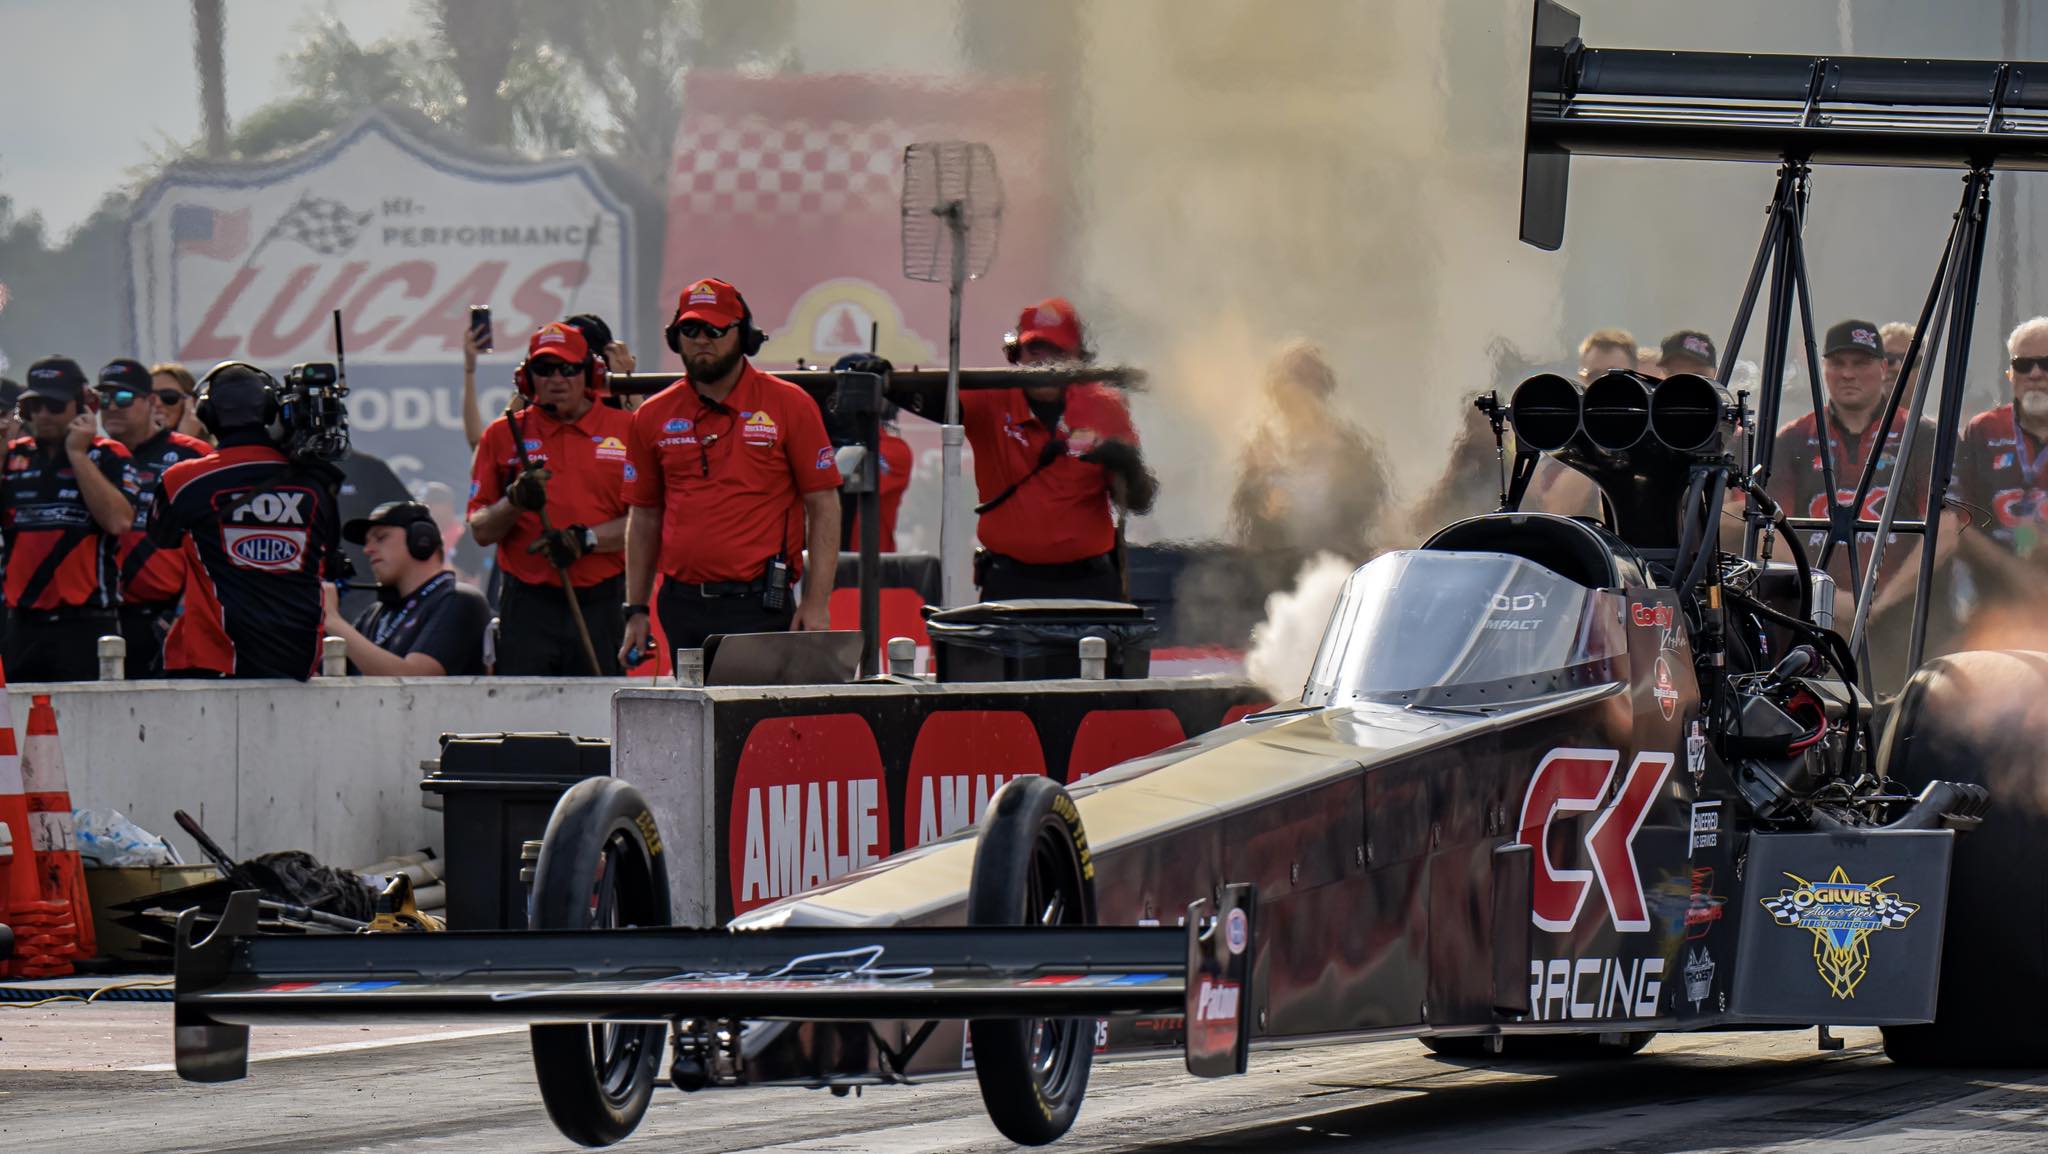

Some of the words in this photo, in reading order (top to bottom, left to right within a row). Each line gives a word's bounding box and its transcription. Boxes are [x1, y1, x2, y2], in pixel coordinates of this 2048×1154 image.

[383, 226, 603, 247] PERFORMANCE
[179, 259, 592, 361] LUCAS
[231, 492, 305, 524] FOX
[241, 543, 296, 560] NHRA
[1491, 590, 1552, 611] ODY
[1486, 619, 1544, 630] MPACT
[1631, 602, 1674, 629] Cody
[741, 778, 881, 902] AMALIE
[1517, 747, 1675, 932] CK
[1793, 887, 1887, 911] OGILVIE'S
[1530, 956, 1665, 1021] RACING
